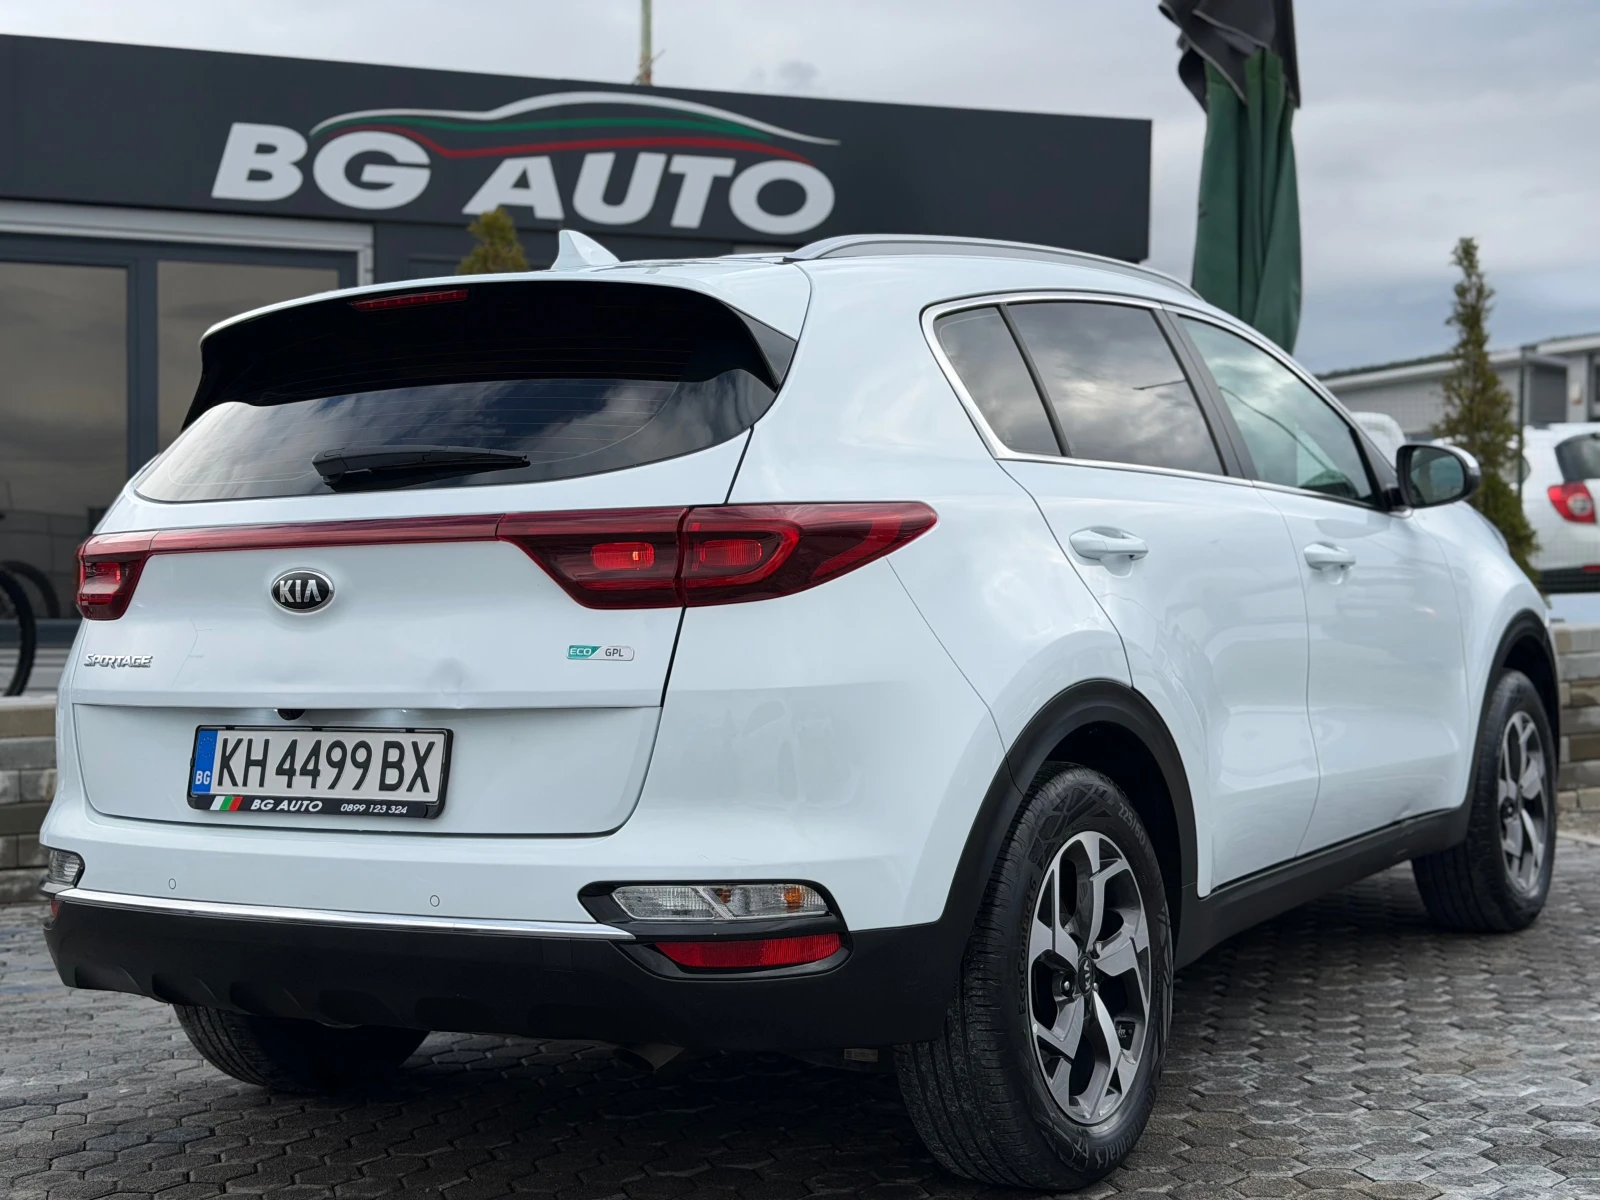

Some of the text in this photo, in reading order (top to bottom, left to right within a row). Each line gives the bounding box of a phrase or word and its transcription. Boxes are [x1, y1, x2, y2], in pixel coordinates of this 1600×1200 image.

[211, 122, 836, 235] BG AUTO
[279, 579, 322, 604] KIA
[569, 647, 624, 658] ECO GPL
[84, 653, 153, 669] SPORTAGE
[194, 770, 211, 785] BG
[250, 799, 323, 812] BG AUTO
[340, 803, 408, 815] 0899 123 324
[1117, 801, 1147, 846] 225/60
[1083, 959, 1092, 991] KIA
